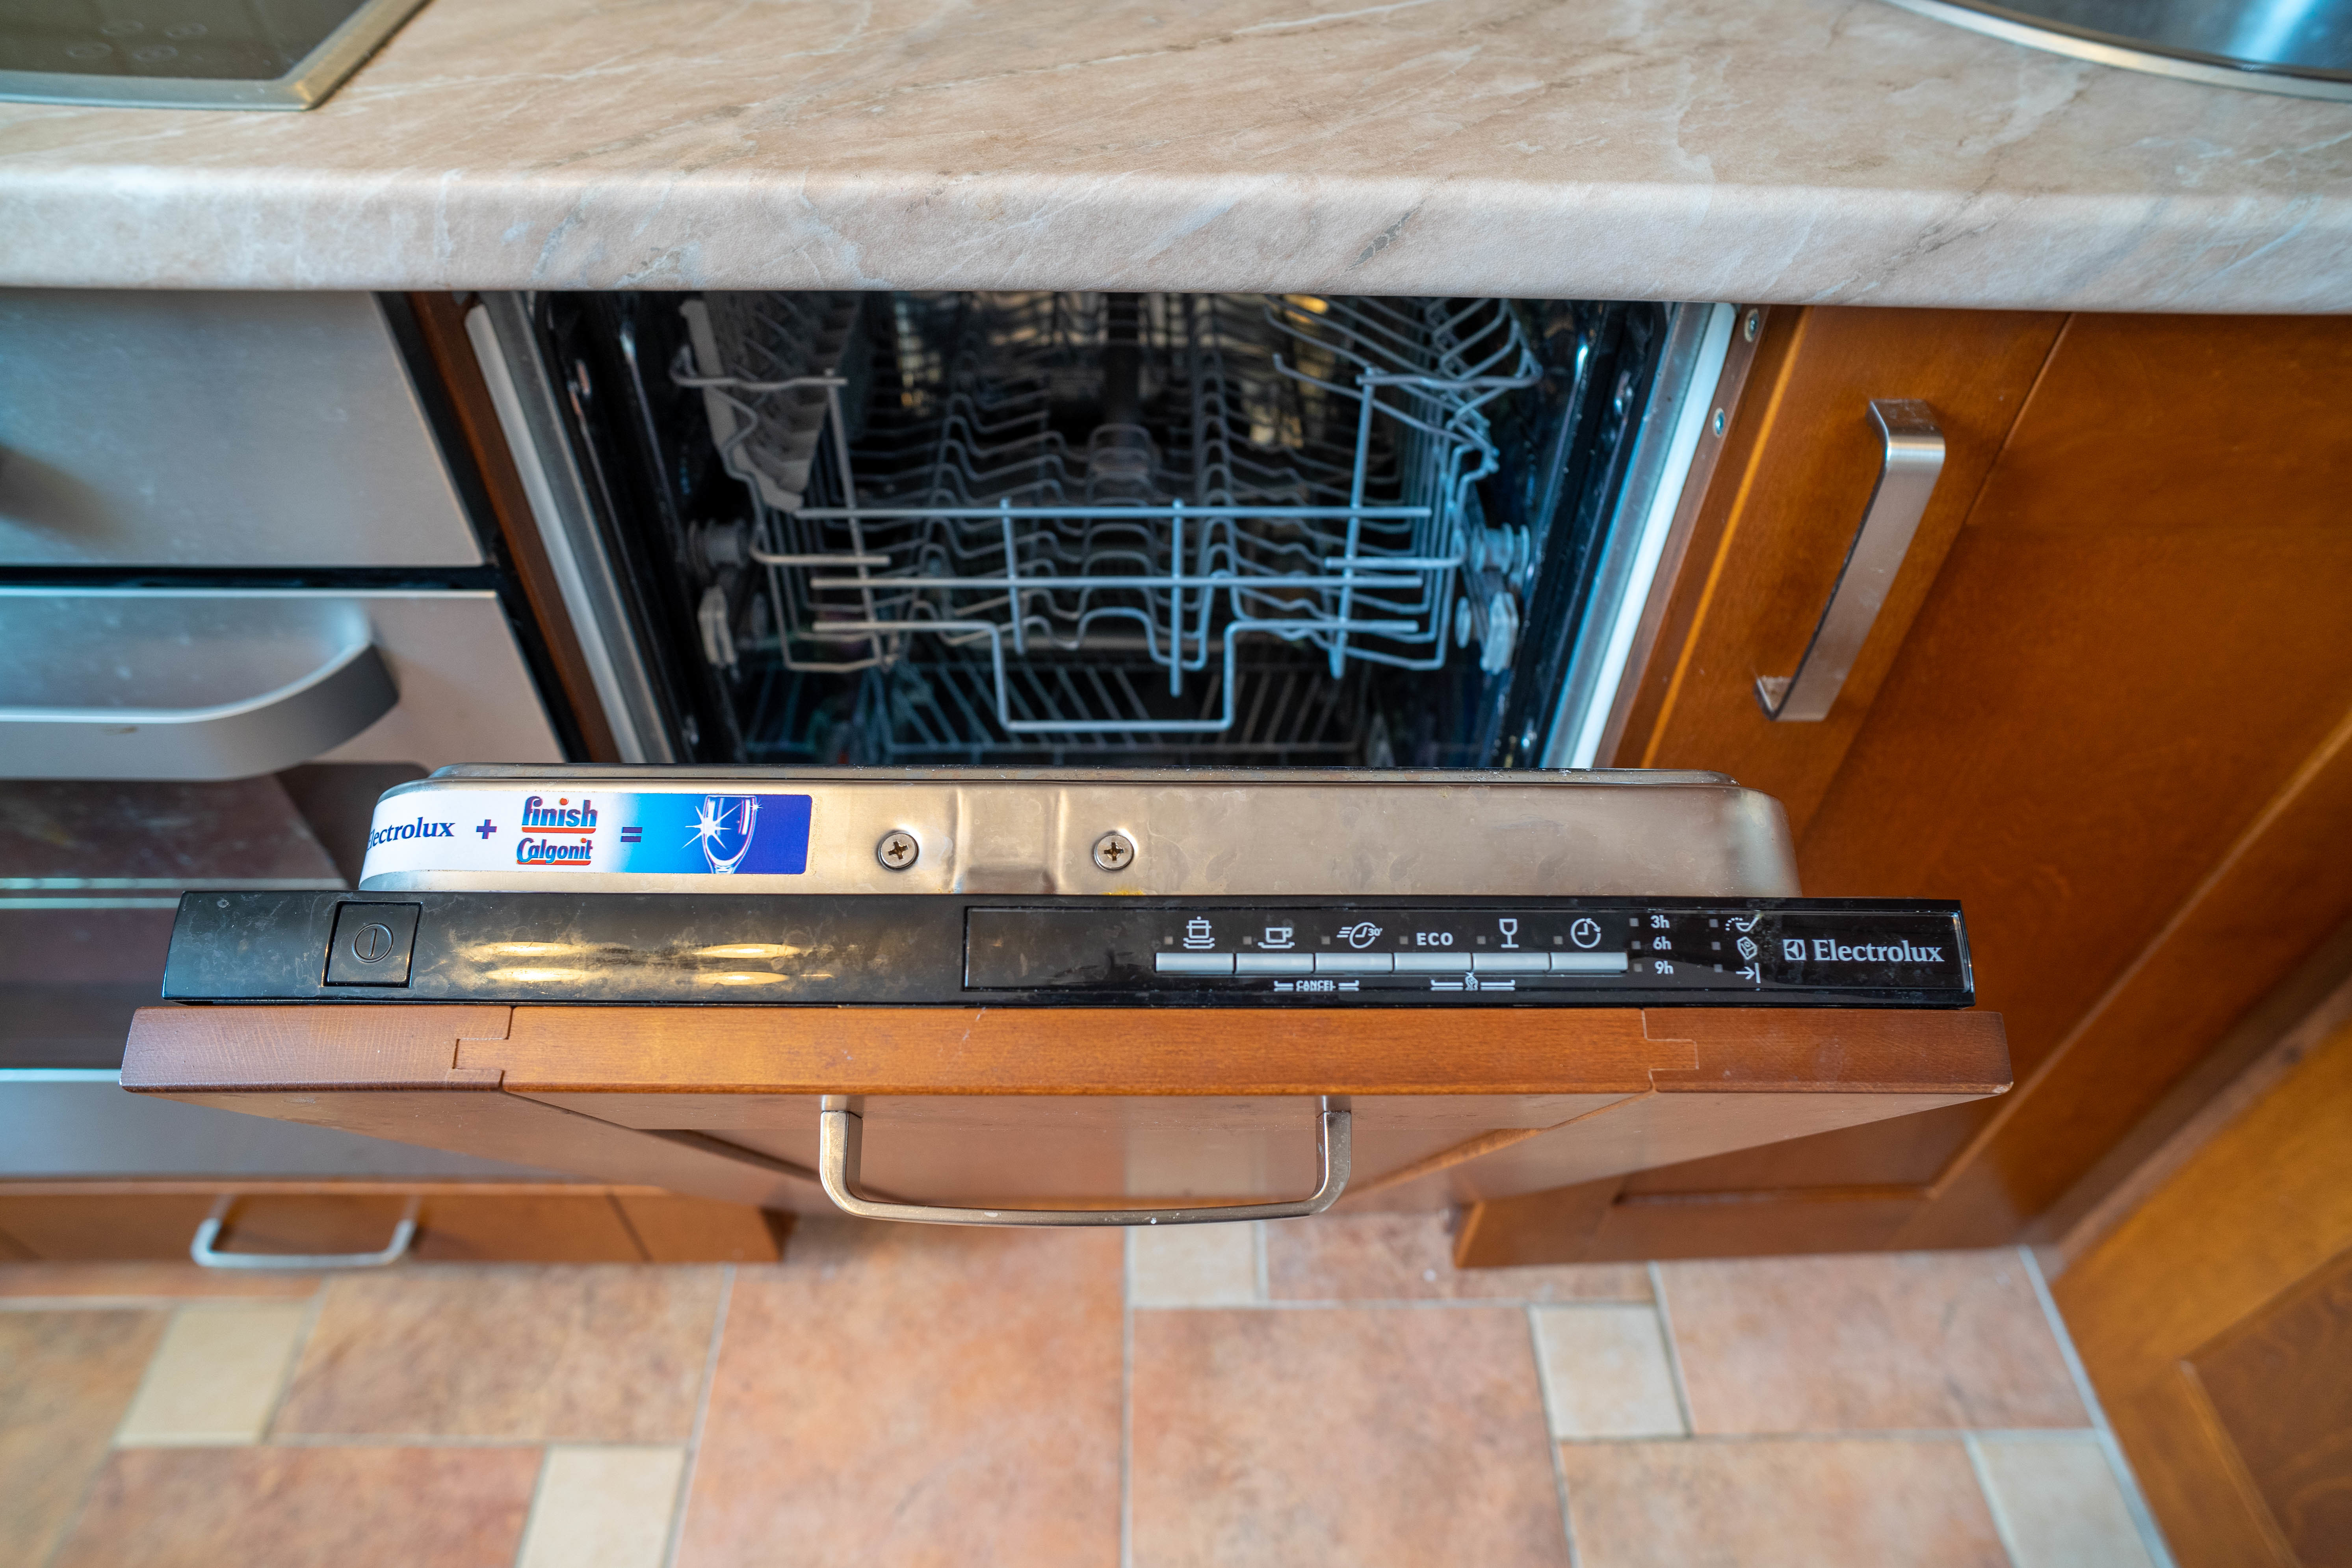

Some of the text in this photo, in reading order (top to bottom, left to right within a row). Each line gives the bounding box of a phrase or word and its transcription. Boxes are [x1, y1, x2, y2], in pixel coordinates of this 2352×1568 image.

[521, 796, 598, 827] finish
[516, 838, 594, 864] Calgonit
[1650, 915, 1670, 928] 3h
[1416, 932, 1454, 946] ECO
[1653, 936, 1672, 950] 6h
[1812, 939, 1945, 961] Electrolux
[1655, 960, 1674, 974] 9h
